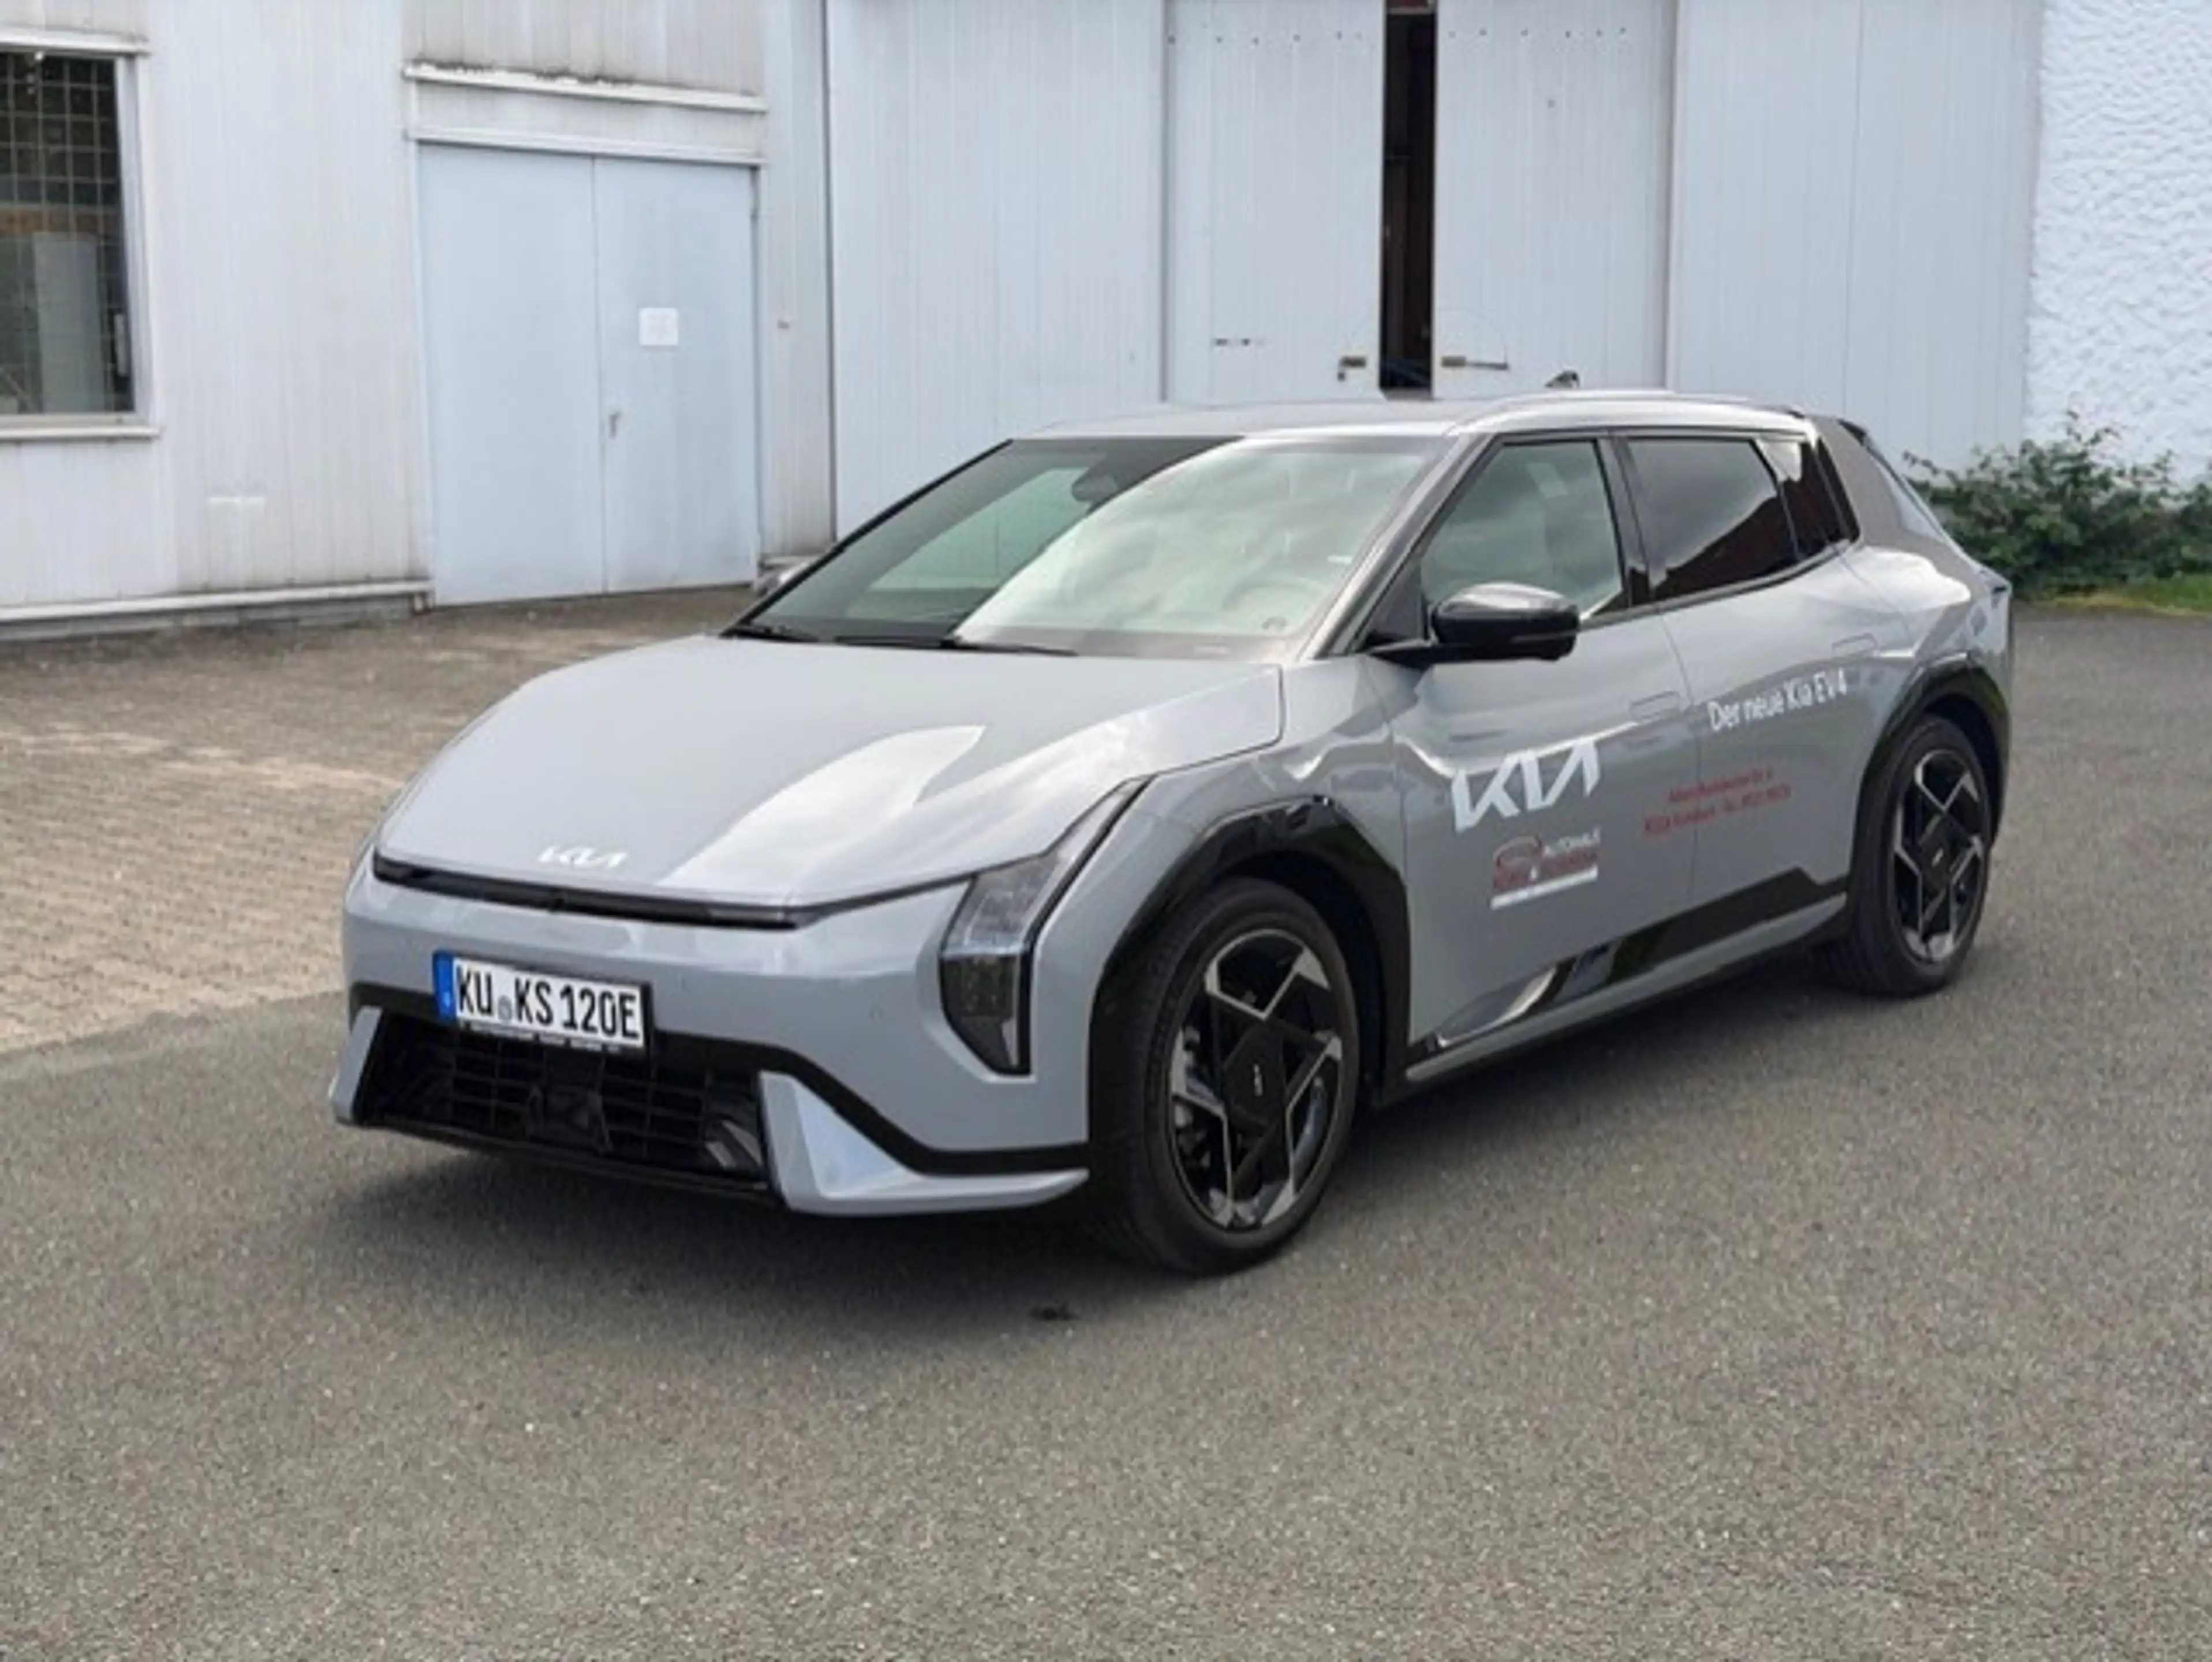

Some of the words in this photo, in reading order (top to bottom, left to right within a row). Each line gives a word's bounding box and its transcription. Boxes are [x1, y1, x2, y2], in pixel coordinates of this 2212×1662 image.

[1707, 701, 1740, 732] Der
[1451, 738, 1600, 832] KIA
[456, 965, 492, 1016] KU
[515, 976, 554, 1025] KS
[560, 984, 639, 1039] 120E
